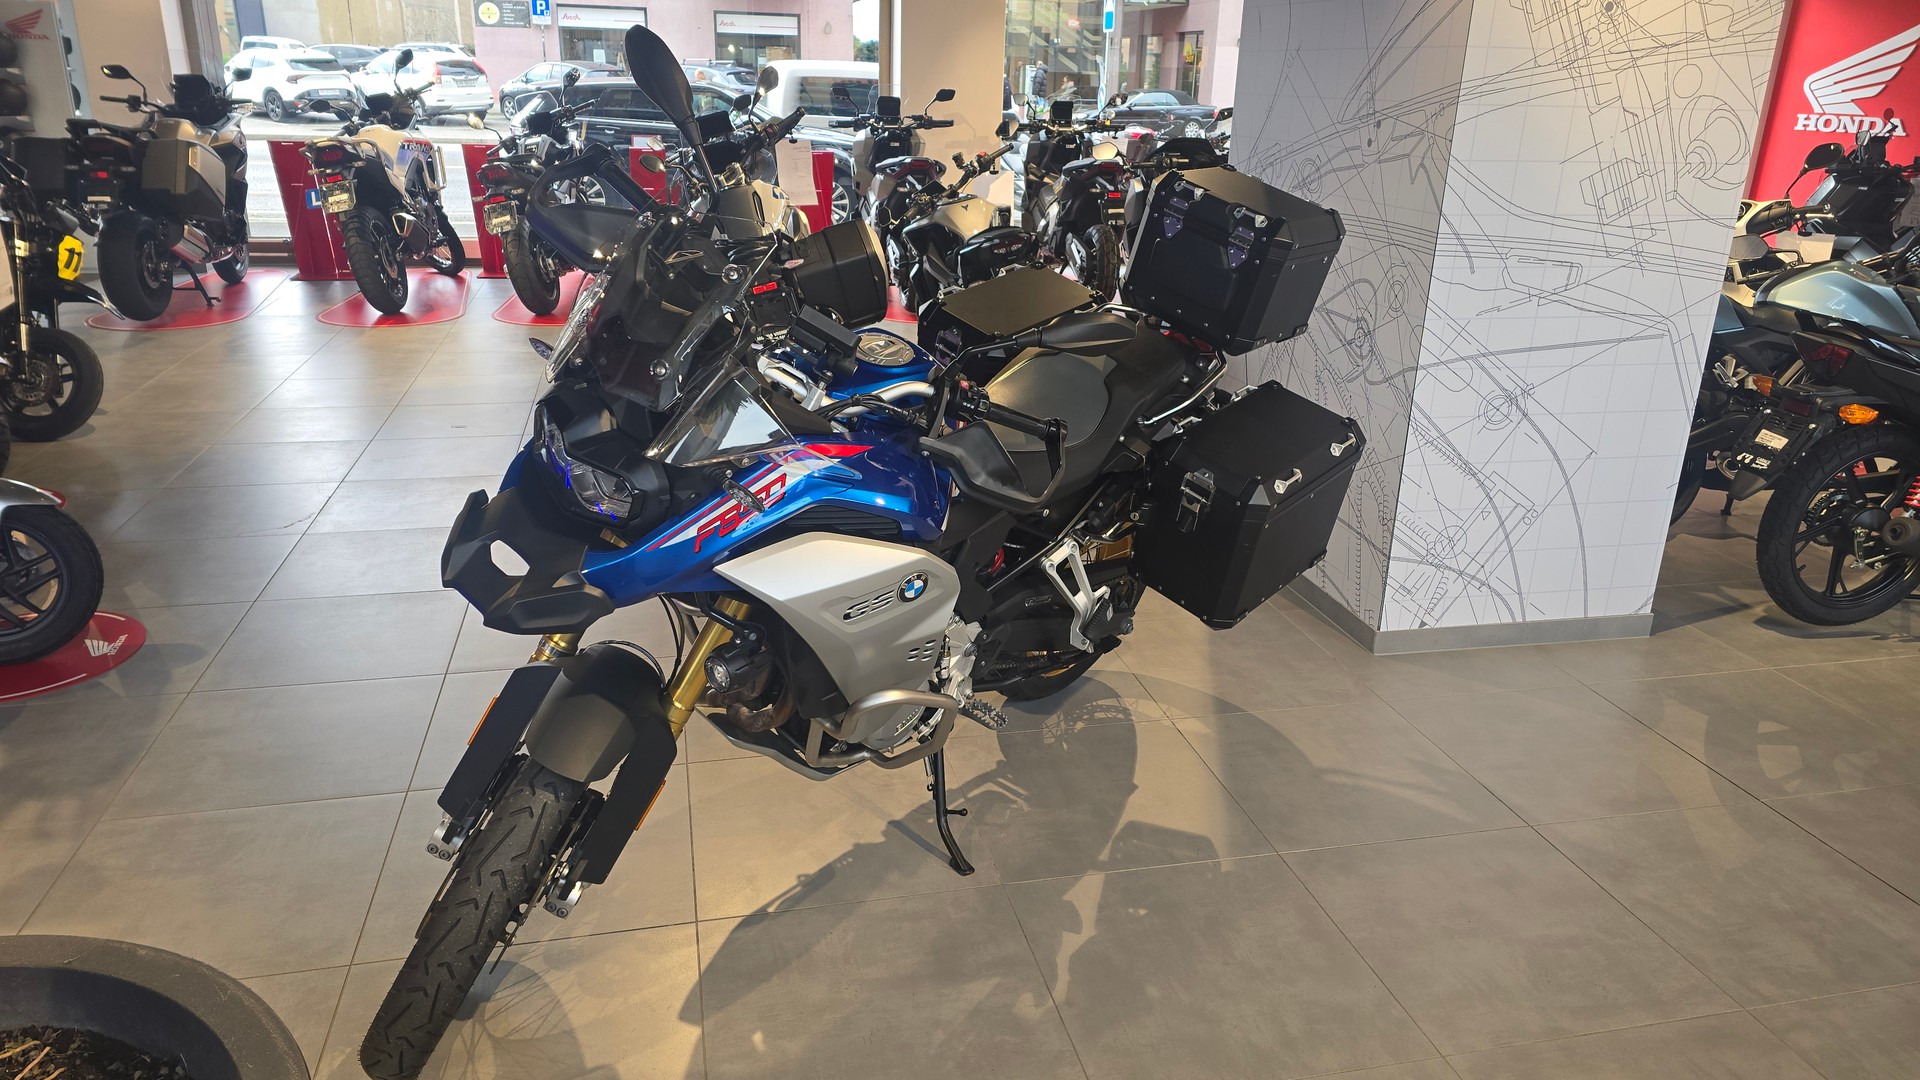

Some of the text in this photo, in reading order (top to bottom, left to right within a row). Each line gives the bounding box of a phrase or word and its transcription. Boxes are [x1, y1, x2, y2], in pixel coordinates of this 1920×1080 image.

[536, 0, 546, 14] P
[1794, 114, 1906, 136] HONDA
[842, 590, 895, 622] GS
